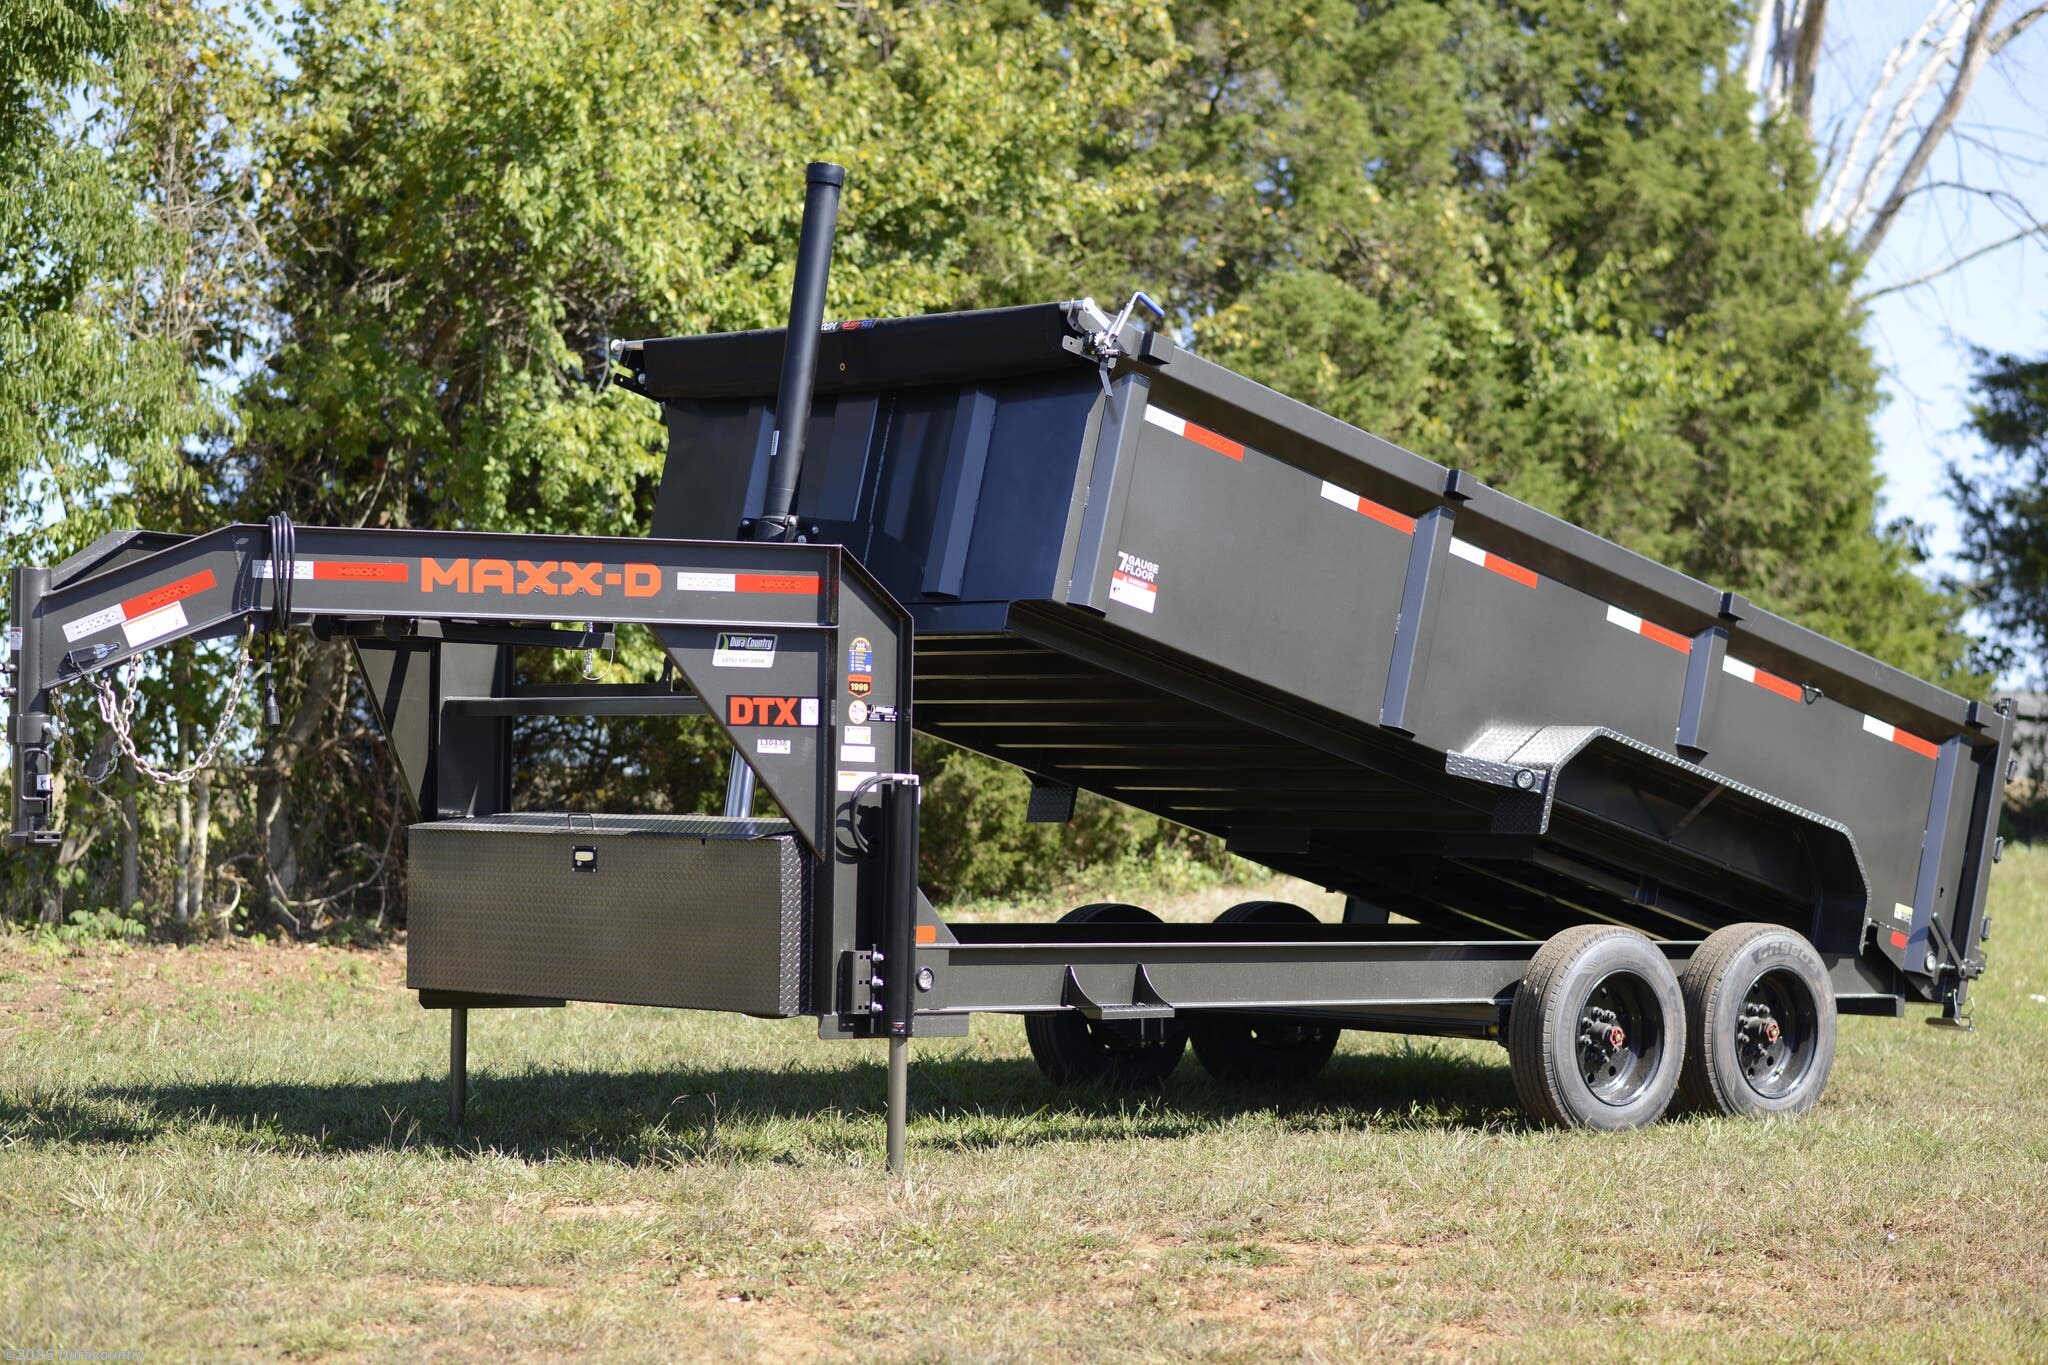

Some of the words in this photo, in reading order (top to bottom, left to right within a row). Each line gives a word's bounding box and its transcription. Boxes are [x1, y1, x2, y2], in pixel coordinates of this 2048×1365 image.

[1118, 550, 1129, 571] 7
[1128, 555, 1159, 574] GAUGE
[1125, 564, 1155, 582] FLOOR
[420, 557, 662, 598] MAXX-D
[730, 636, 746, 647] Dura
[747, 637, 773, 650] Country
[730, 697, 798, 725] DTX
